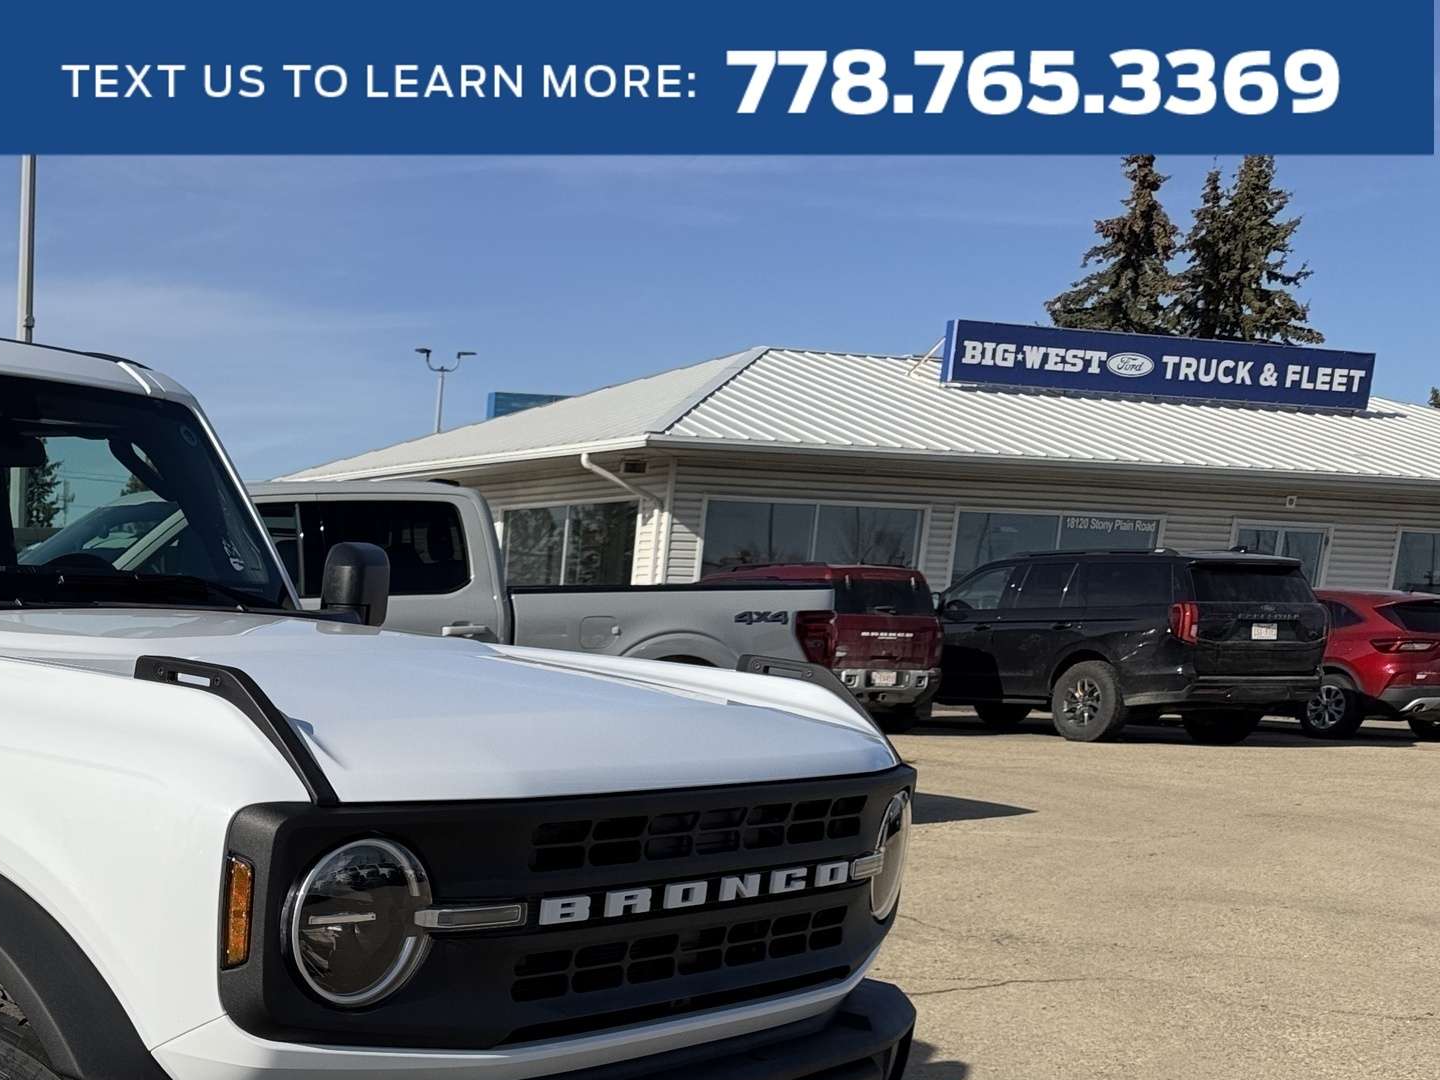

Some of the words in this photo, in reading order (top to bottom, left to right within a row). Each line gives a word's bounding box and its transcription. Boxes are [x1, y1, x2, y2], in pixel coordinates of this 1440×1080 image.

[961, 340, 1017, 368] BIG
[1022, 345, 1108, 375] WEST
[1161, 355, 1255, 386] TRUCK
[1258, 362, 1279, 388] &
[1284, 364, 1366, 393] FLEET
[1089, 518, 1114, 533] Stony
[1114, 519, 1134, 531] Plain
[1135, 520, 1157, 532] Road
[538, 860, 850, 927] BRONCO
